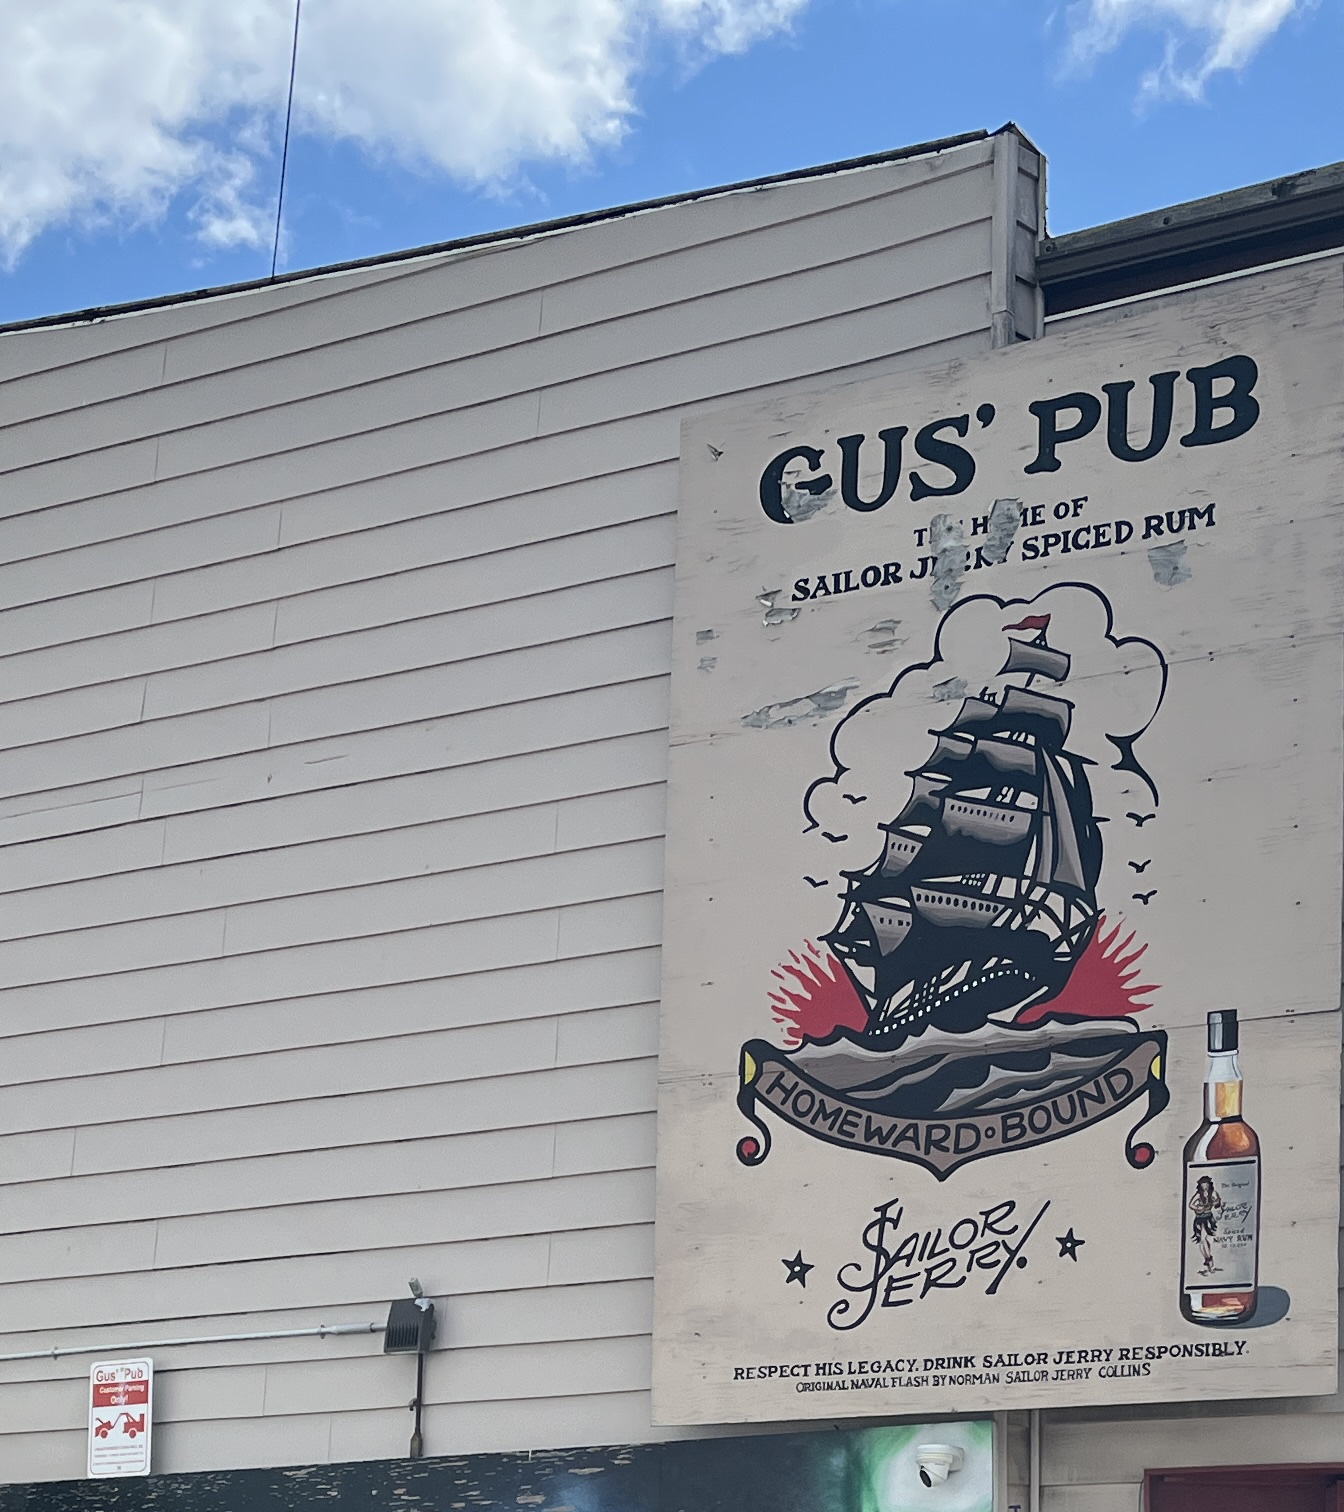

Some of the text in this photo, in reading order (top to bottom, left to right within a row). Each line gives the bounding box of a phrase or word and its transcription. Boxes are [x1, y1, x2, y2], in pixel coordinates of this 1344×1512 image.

[760, 354, 1261, 524] GUS' PUB
[971, 504, 1045, 536] HE
[1054, 496, 1088, 519] OF
[792, 562, 902, 602] SAILOR
[1021, 521, 1133, 563] SPICED
[1142, 503, 1217, 541] RUM
[766, 1067, 1134, 1155] HOMEWARD BOUND
[124, 1367, 144, 1380] Pub
[733, 1341, 1250, 1381] RESPECT HIS LEGACY. DRINK SAILOR JERRY RESPONSIBLY.
[796, 1363, 1151, 1393] ORIGINAL NAVAL FLASH BY NORMAN SAILOR JERRY COLLINS
